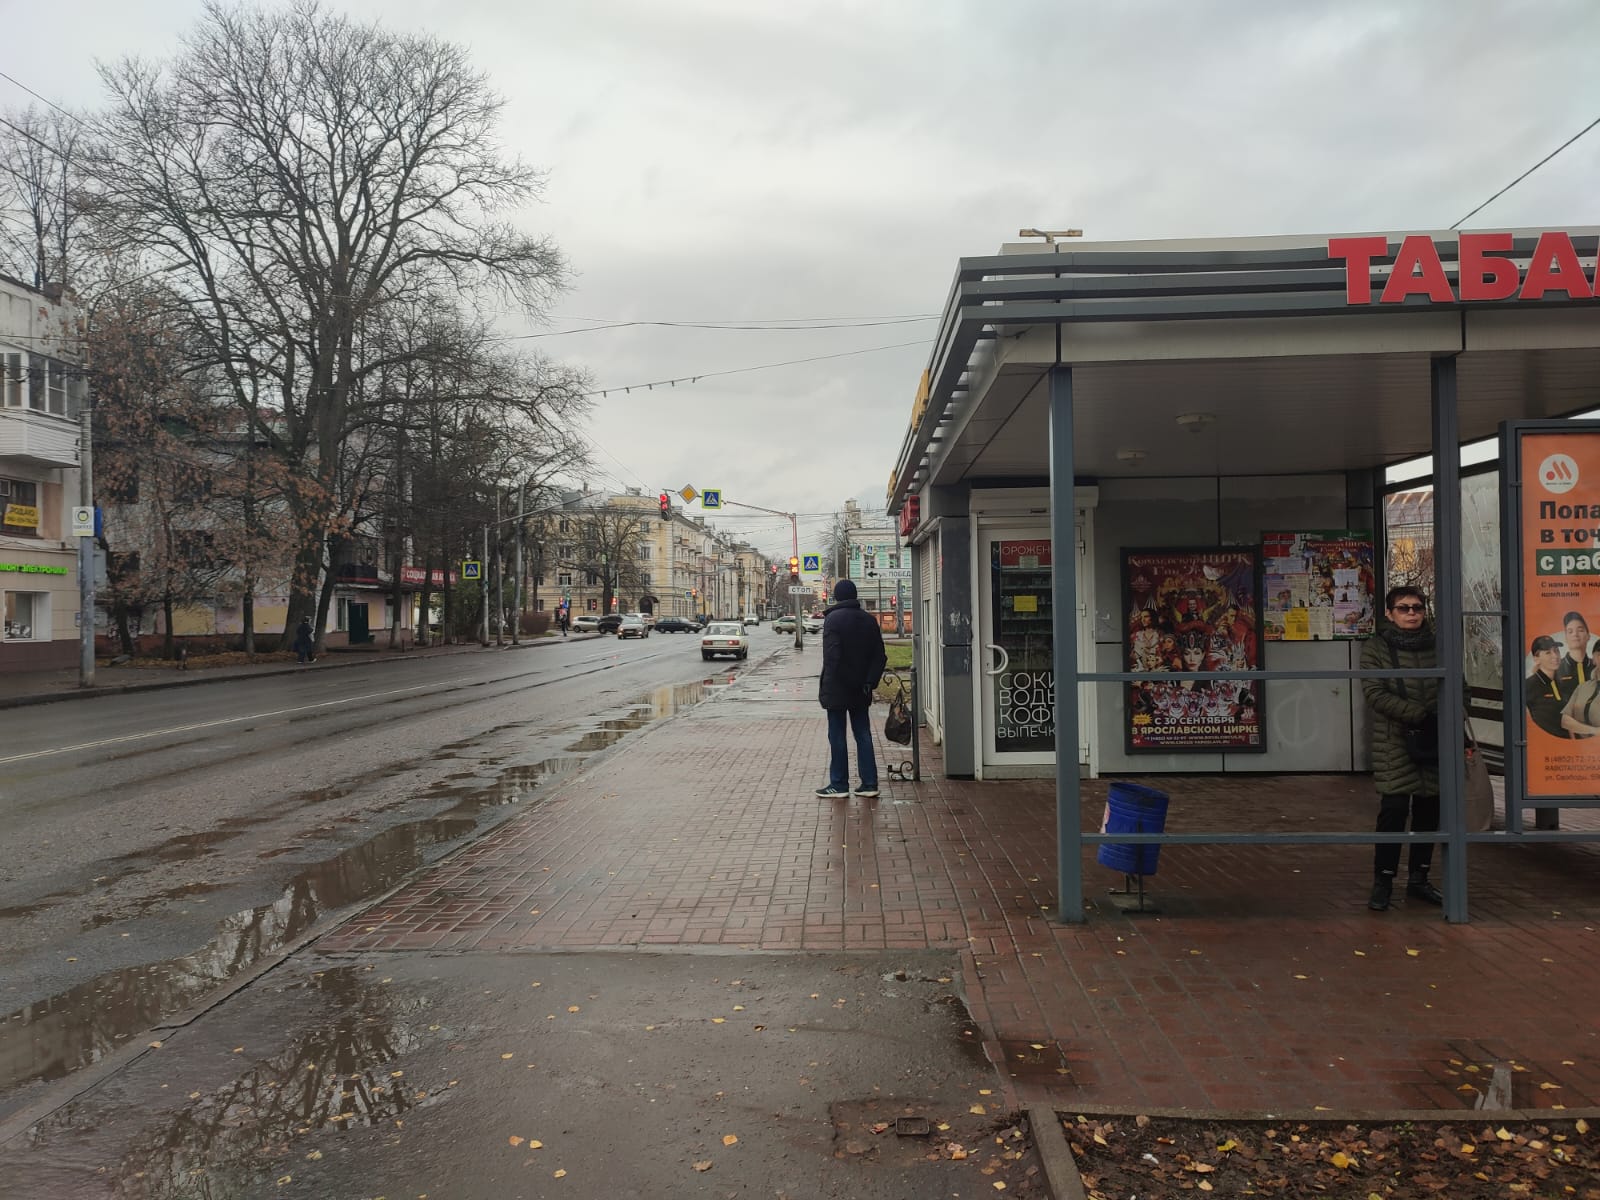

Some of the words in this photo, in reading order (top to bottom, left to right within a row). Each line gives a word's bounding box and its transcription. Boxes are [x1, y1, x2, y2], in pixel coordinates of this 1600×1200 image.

[1328, 231, 1600, 305] ТАБА
[1540, 529, 1555, 543] в
[1540, 555, 1555, 571] с
[1000, 706, 1055, 724] КОФ
[1154, 717, 1162, 725] С
[1164, 717, 1177, 725] 30
[1179, 716, 1235, 725] СЕНТЯБРЯ
[1132, 727, 1138, 735] В
[1141, 726, 1221, 735] ЯРОСЛАВСКОМ
[1223, 726, 1259, 736] ЦИРКЕ
